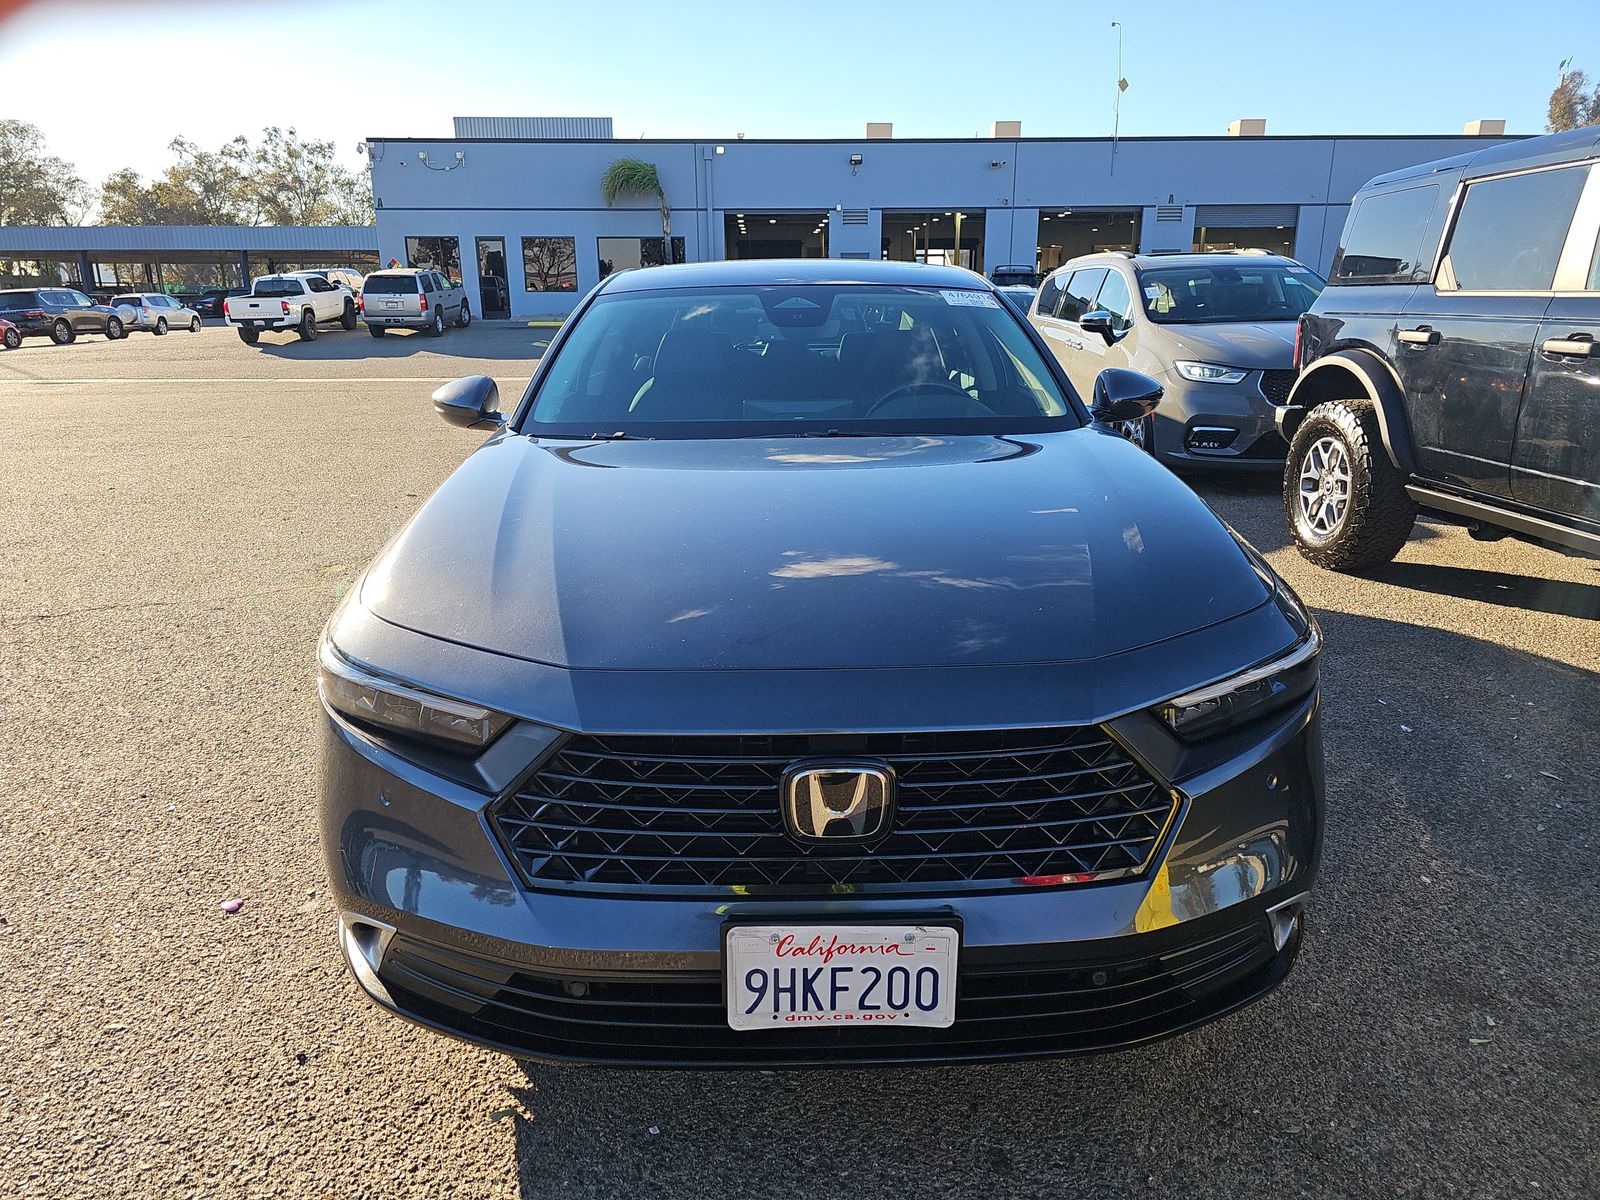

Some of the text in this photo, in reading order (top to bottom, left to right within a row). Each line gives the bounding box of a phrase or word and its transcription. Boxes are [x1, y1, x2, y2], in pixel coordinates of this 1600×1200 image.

[776, 934, 914, 963] California
[745, 966, 939, 1015] 9HKF200
[785, 1013, 897, 1021] dmv.ca.gov
